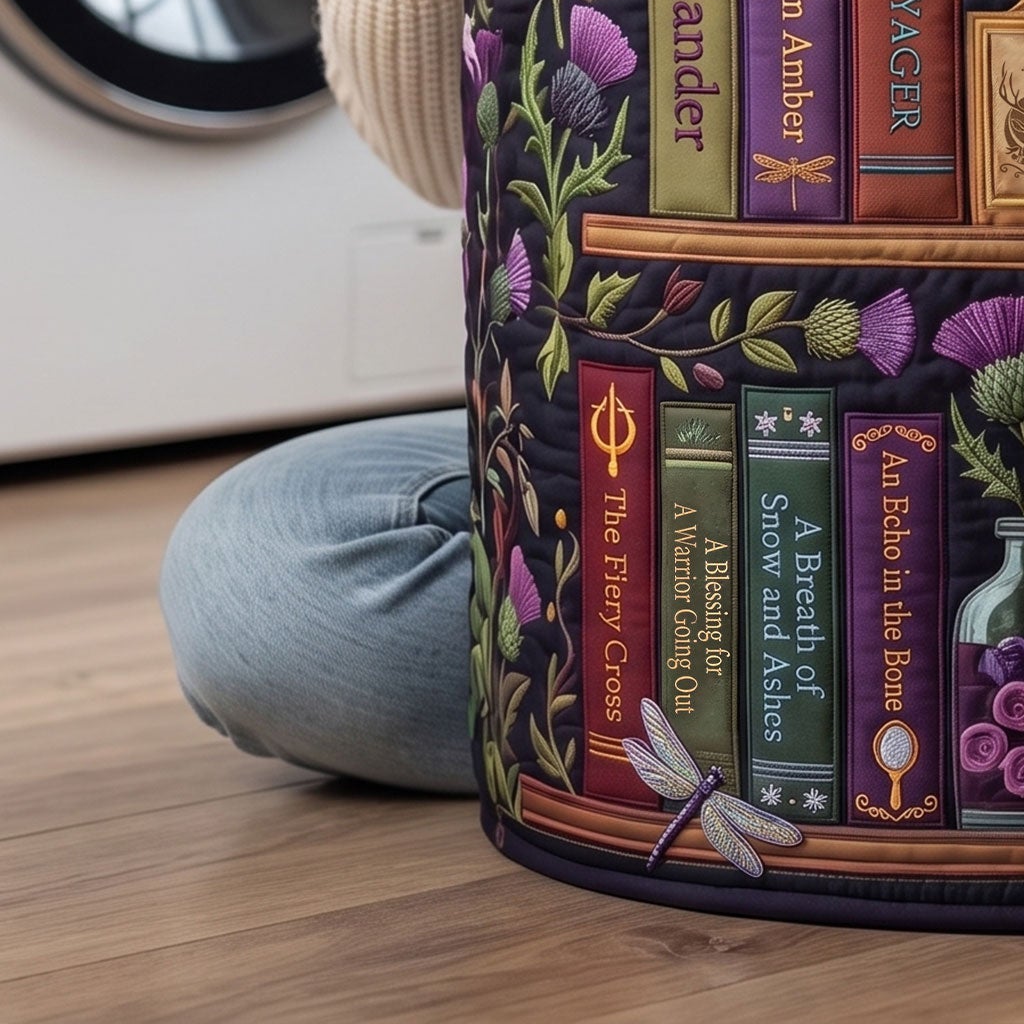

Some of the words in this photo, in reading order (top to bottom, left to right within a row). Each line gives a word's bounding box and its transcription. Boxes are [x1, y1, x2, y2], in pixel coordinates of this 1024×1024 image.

[780, 29, 814, 144] Amber
[881, 450, 908, 488] An
[604, 488, 628, 544] The
[673, 502, 697, 520] A
[760, 492, 788, 578] Snow
[794, 516, 822, 541] A
[673, 524, 697, 603] Warrior
[704, 537, 728, 554] A
[599, 553, 629, 633] Fiery
[697, 561, 730, 643] Blessing
[795, 551, 826, 654] Breath
[883, 568, 911, 593] in
[666, 608, 698, 670] Going
[763, 587, 790, 642] and
[883, 601, 913, 641] the
[604, 640, 628, 723] Cross
[704, 647, 731, 676] for
[796, 664, 826, 700] of
[883, 648, 911, 712] Bone
[673, 675, 698, 714] Out
[763, 652, 792, 743] Ashes
